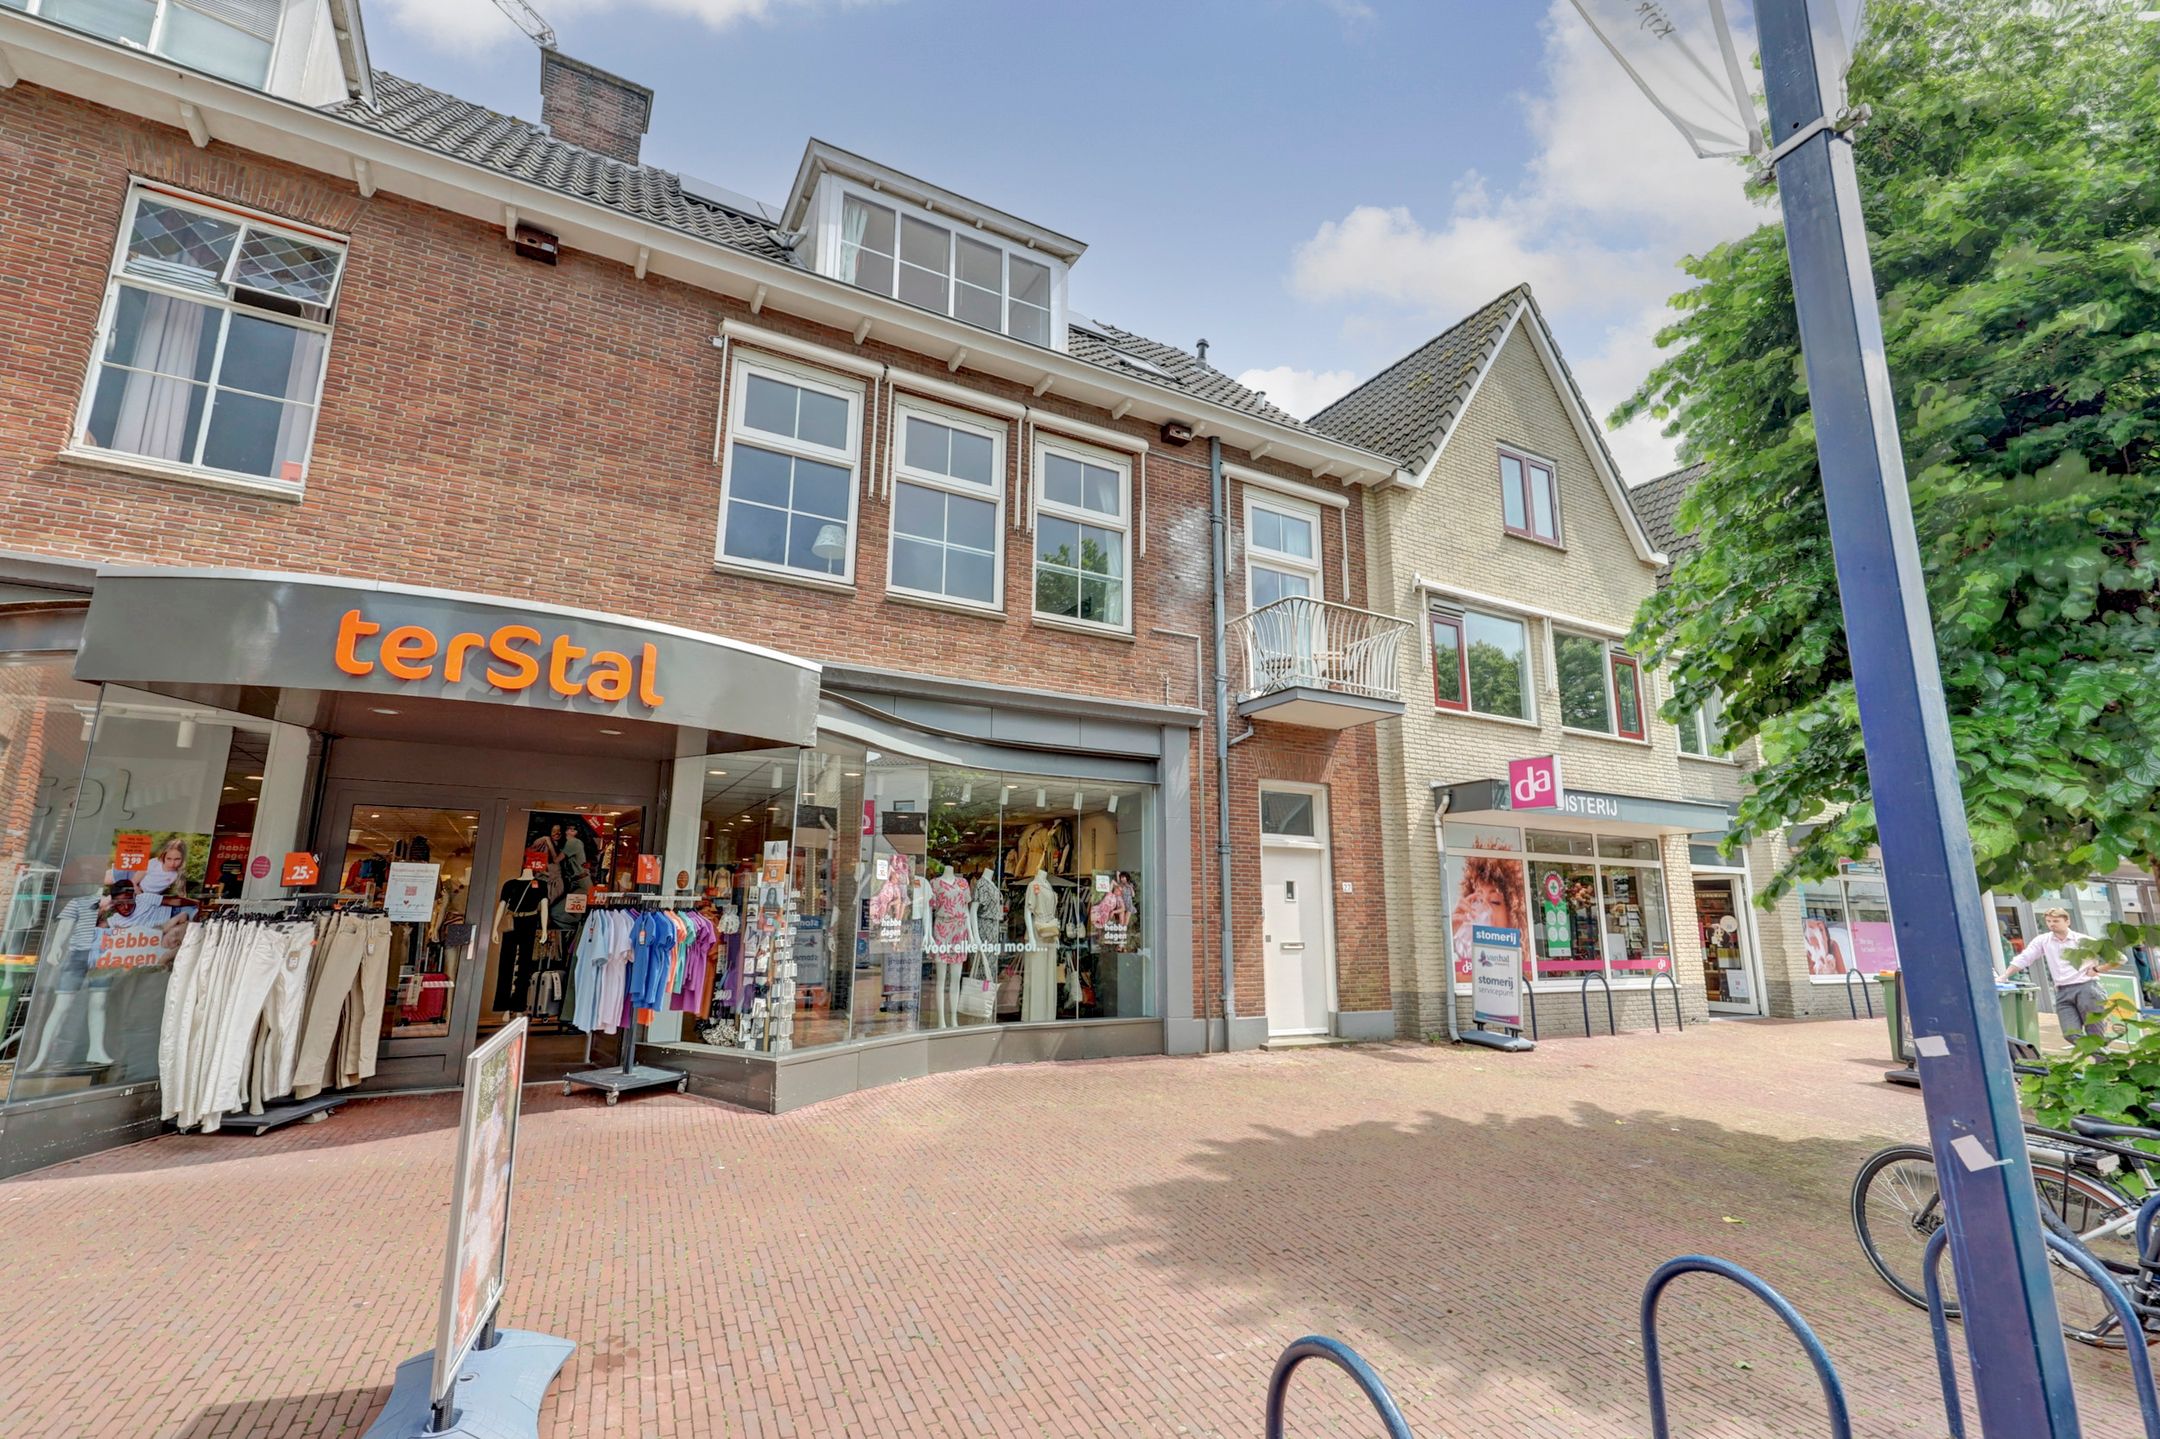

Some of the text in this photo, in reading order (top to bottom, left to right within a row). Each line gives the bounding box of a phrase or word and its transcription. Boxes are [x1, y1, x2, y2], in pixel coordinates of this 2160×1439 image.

[334, 609, 664, 707] terStal
[1515, 766, 1551, 801] da
[1560, 794, 1618, 817] ISTERIJ
[101, 930, 160, 949] hebbe
[1104, 932, 1127, 941] dagen
[1476, 930, 1517, 945] stomerij
[924, 942, 952, 954] voor
[954, 941, 978, 953] elke
[980, 940, 1002, 955] dag
[96, 952, 157, 971] dagen
[1478, 975, 1514, 990] stomerij
